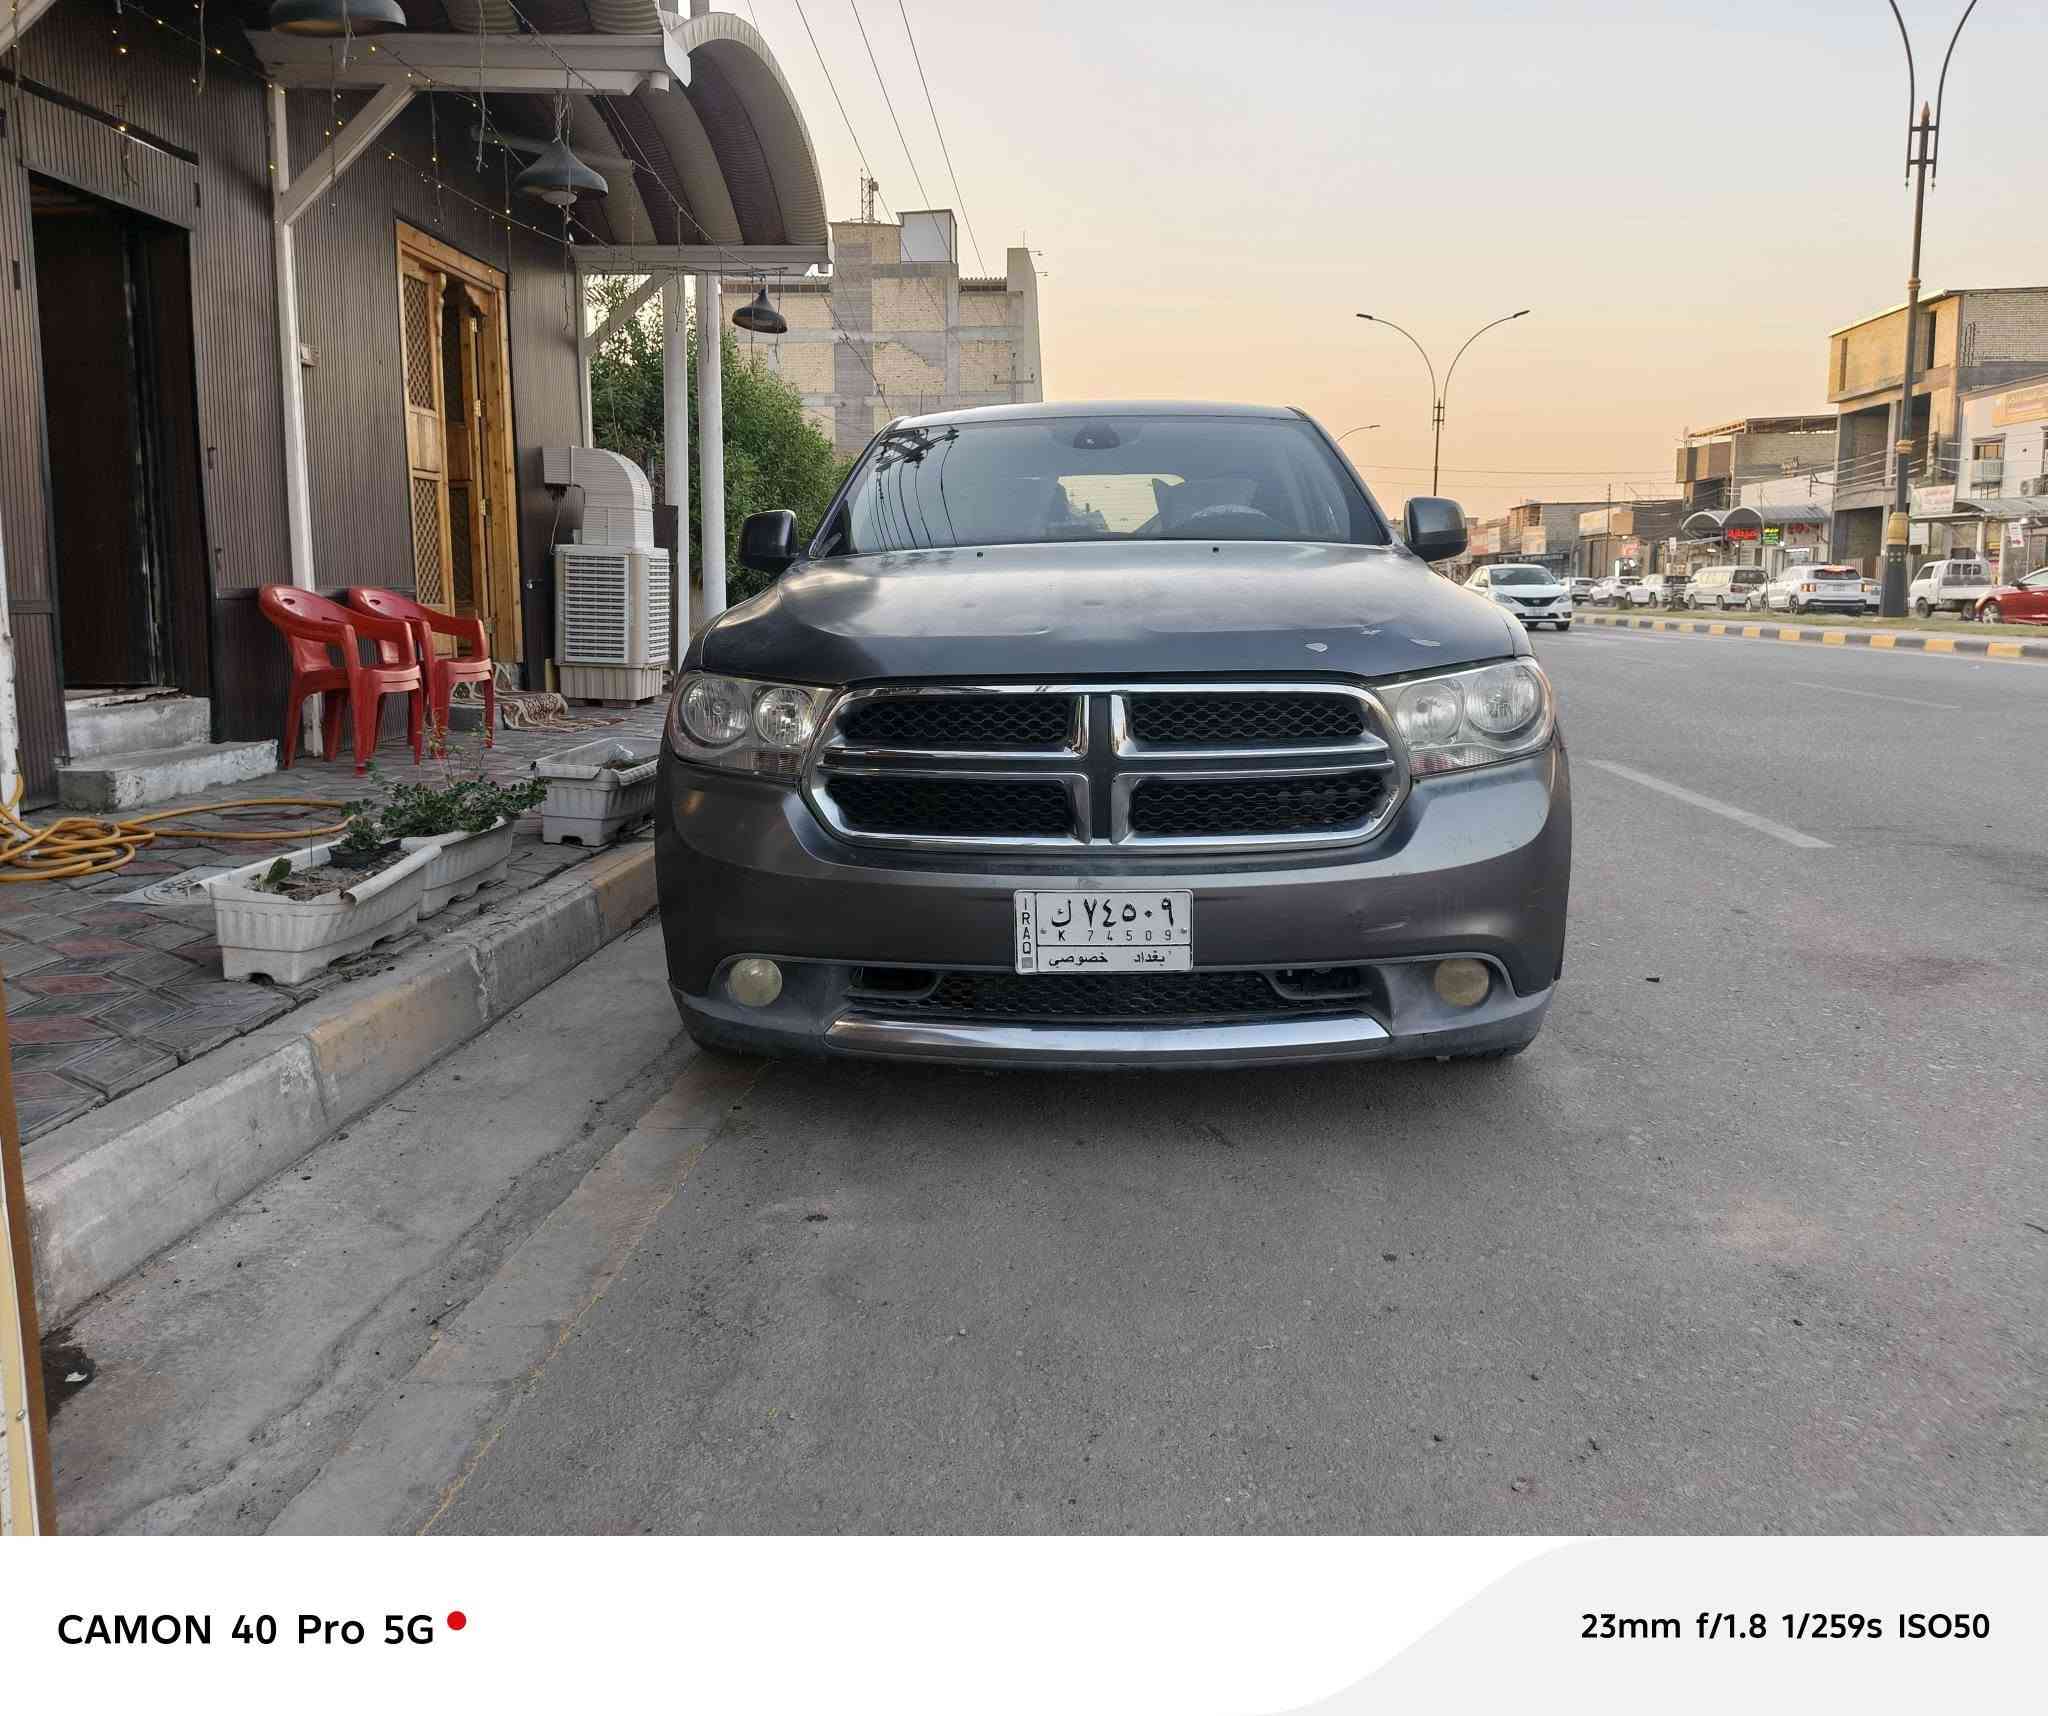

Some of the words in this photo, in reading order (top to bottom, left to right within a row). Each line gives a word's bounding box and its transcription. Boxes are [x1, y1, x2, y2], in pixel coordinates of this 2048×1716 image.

[1021, 897, 1033, 955] IRAQ
[1058, 929, 1066, 942] K
[1048, 952, 1109, 969] خصوصي
[1133, 950, 1165, 967] بغداد
